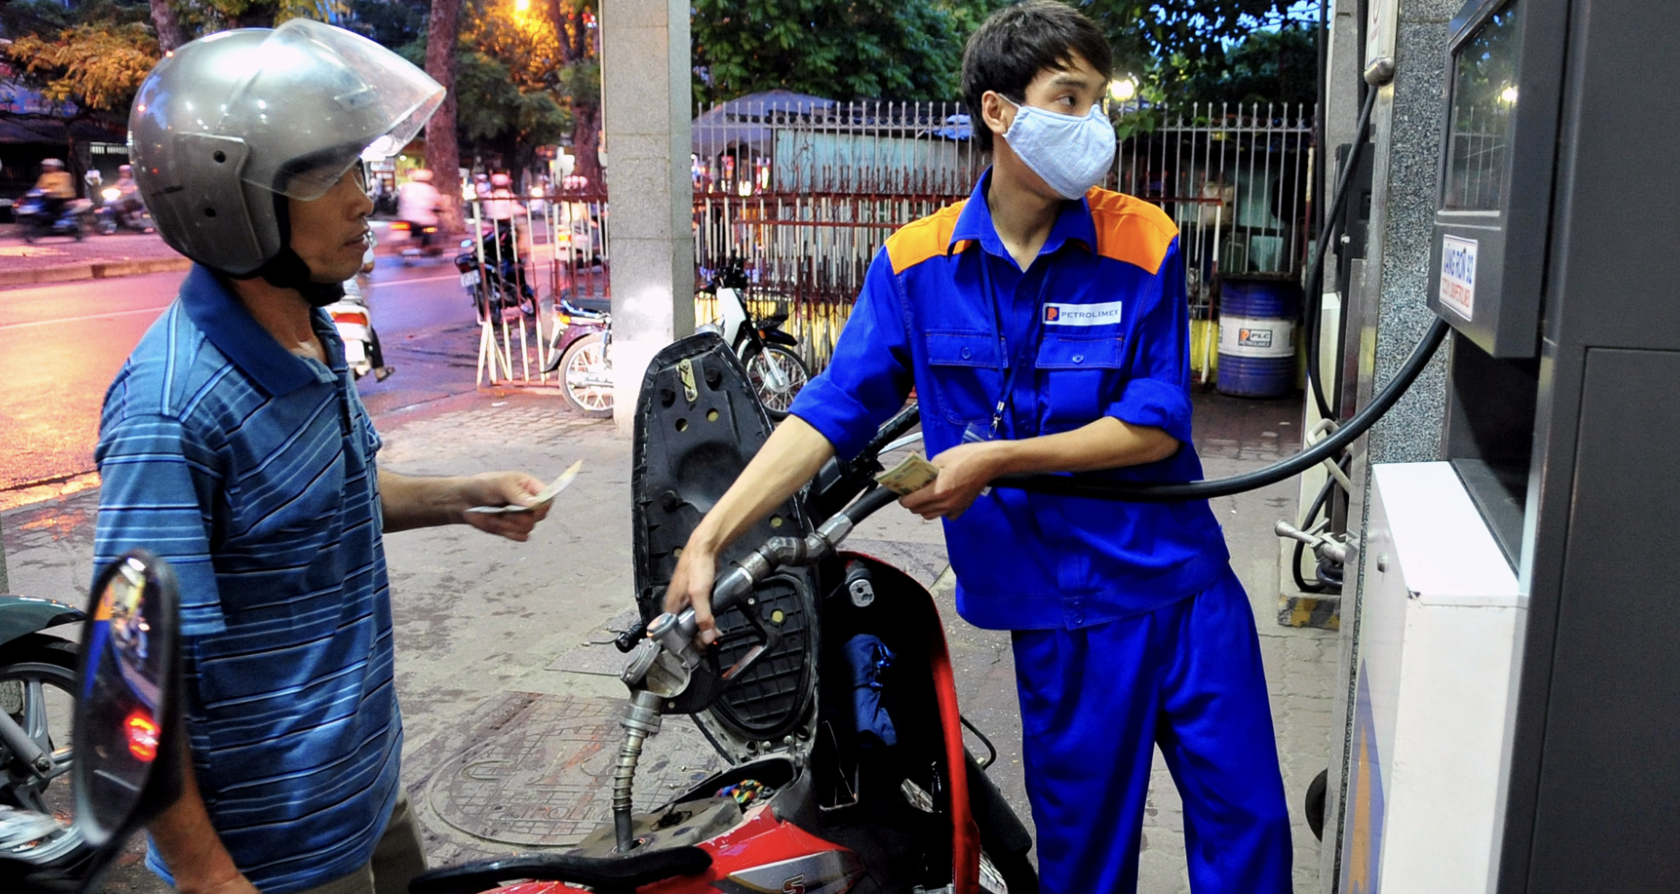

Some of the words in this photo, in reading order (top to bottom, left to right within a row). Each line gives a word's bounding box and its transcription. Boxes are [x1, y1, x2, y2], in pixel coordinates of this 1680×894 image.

[1466, 254, 1474, 285] 92
[1061, 309, 1119, 319] PETROLIMEX
[782, 873, 806, 894] S
